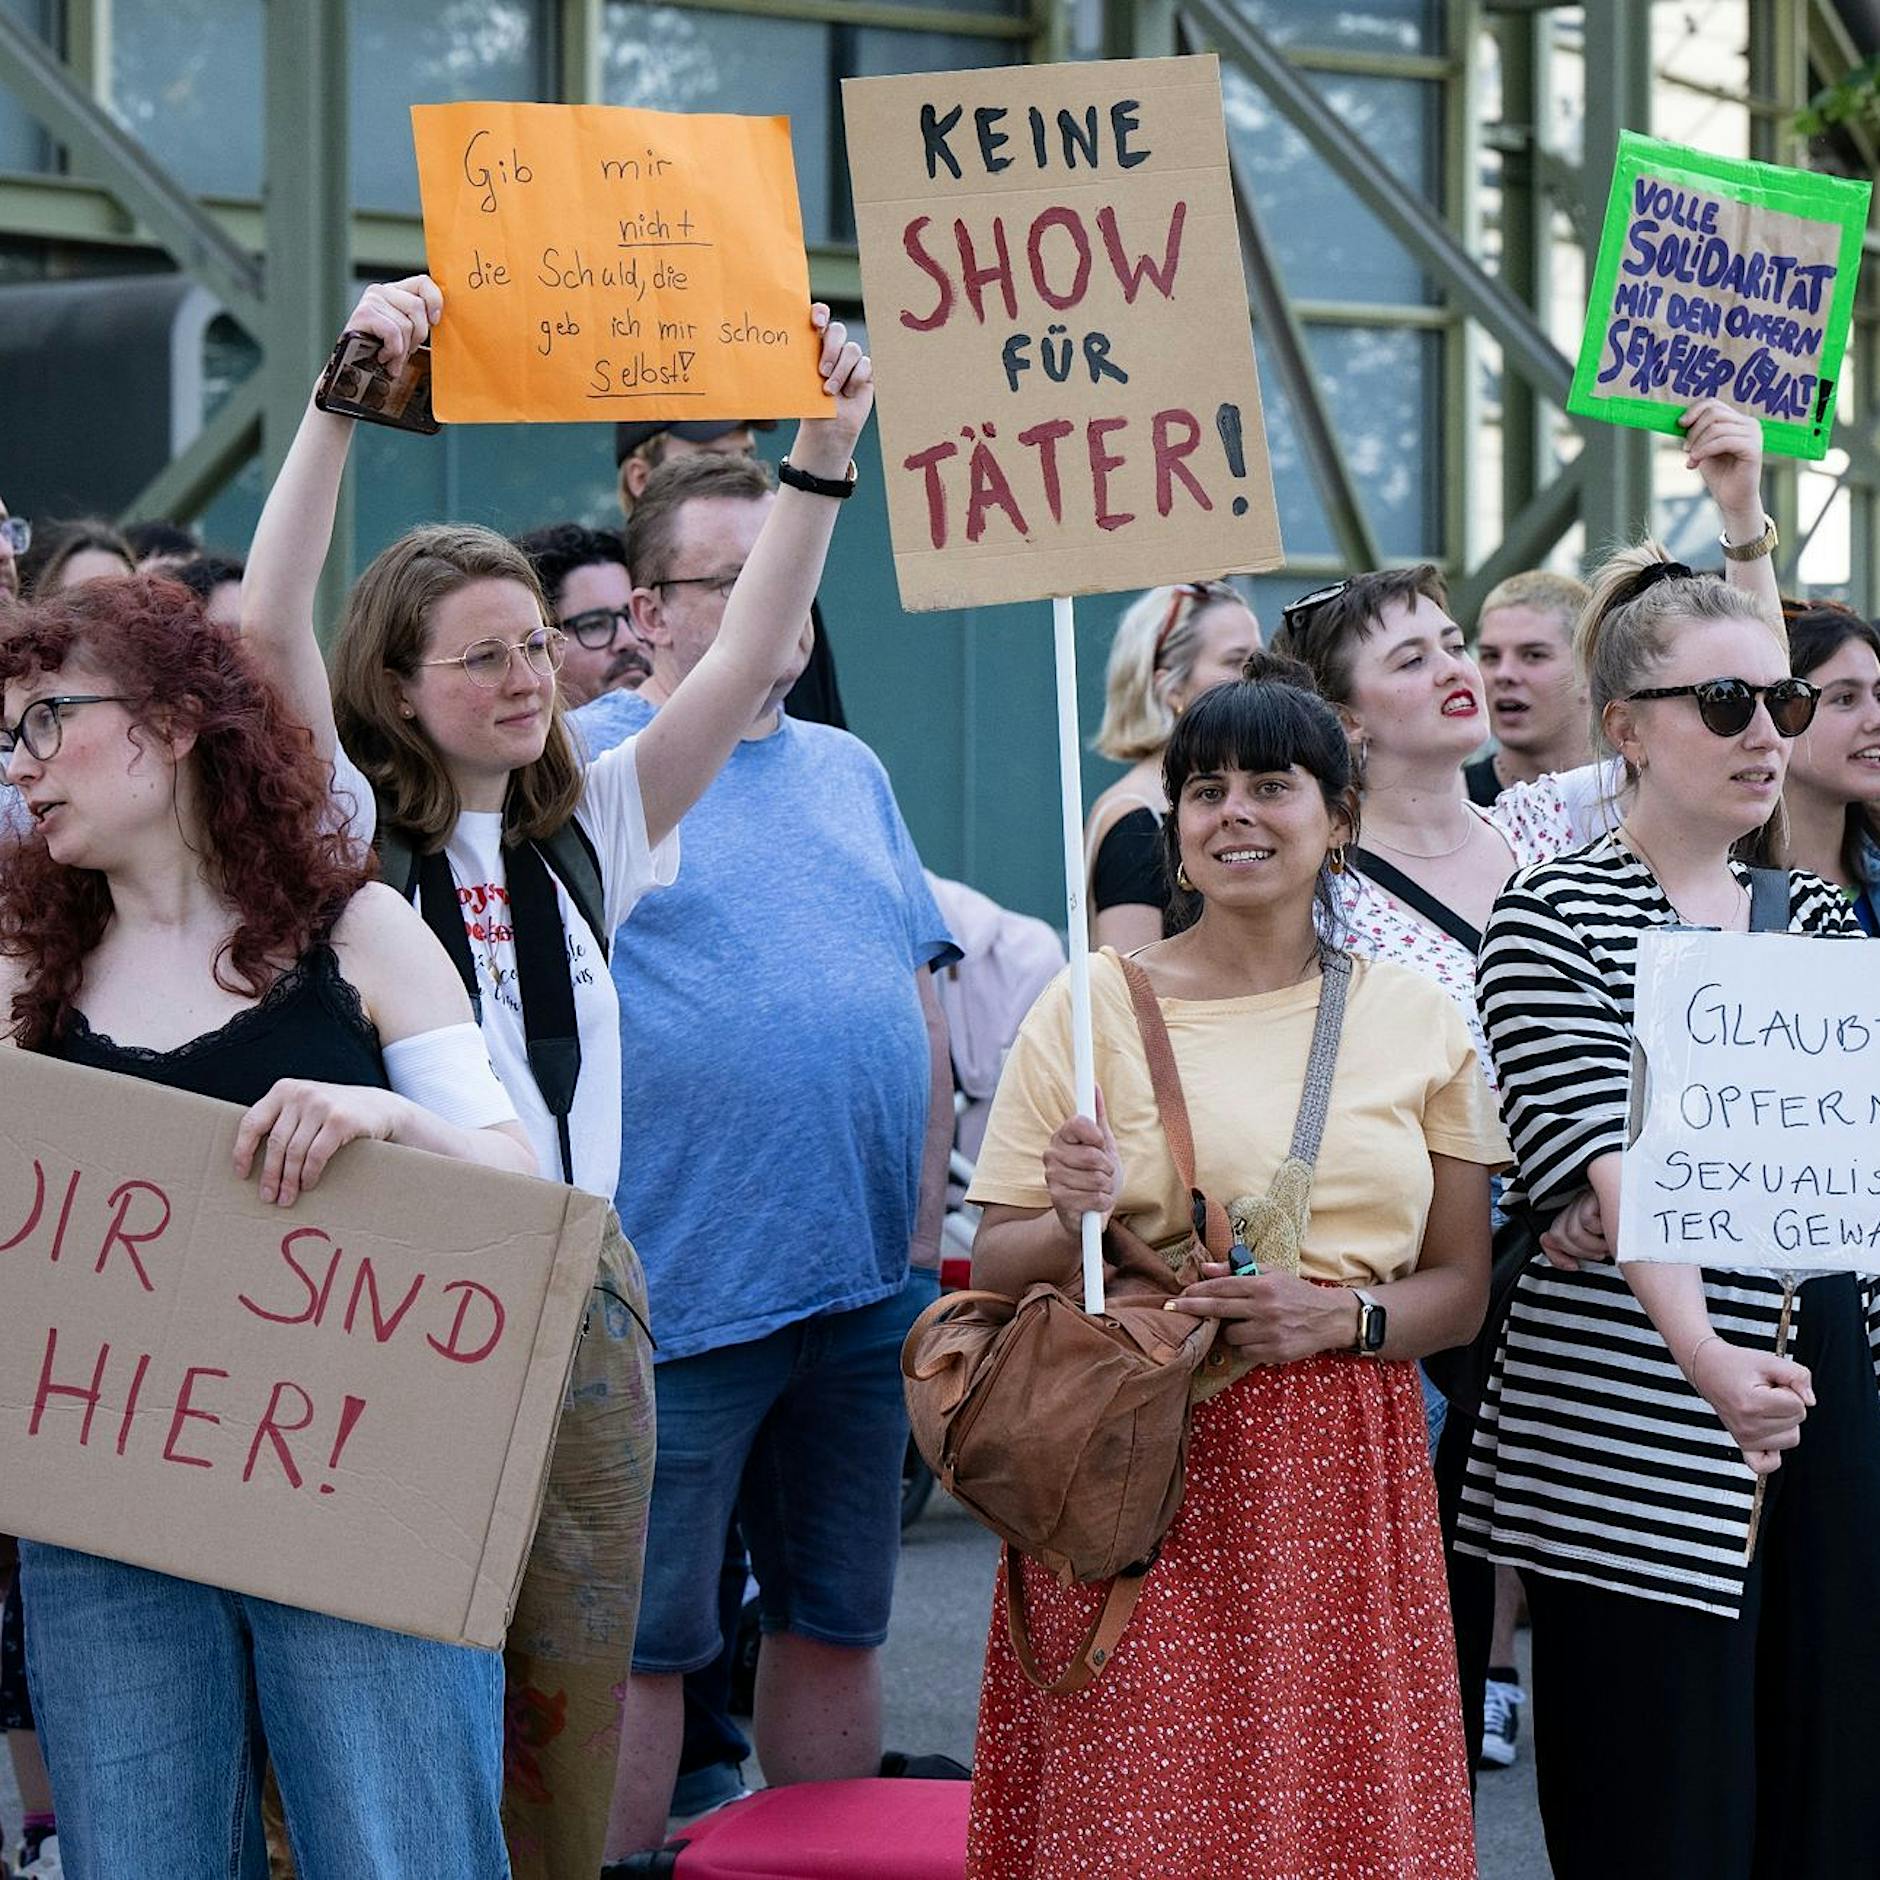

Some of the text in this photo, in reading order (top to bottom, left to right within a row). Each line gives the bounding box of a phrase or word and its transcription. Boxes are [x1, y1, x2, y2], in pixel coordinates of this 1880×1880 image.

[464, 130, 673, 213] Gib mir
[920, 100, 1151, 179] KEINE
[618, 209, 696, 242] nicht
[1634, 178, 1719, 235] VOLLE
[468, 248, 688, 301] die Schuld, die
[899, 200, 1186, 331] SHOW
[538, 308, 790, 356] geb ich mir schon
[1002, 324, 1129, 392] FÜR
[1666, 293, 1722, 339] DEN
[1725, 305, 1823, 357] OPFERN
[589, 351, 696, 392] Selbst!
[903, 402, 1248, 549] TÄTER!
[1686, 983, 1880, 1055] GLAUB
[1653, 1208, 1744, 1244] TER
[238, 1227, 506, 1364] SIND
[28, 1326, 367, 1495] HIER!
